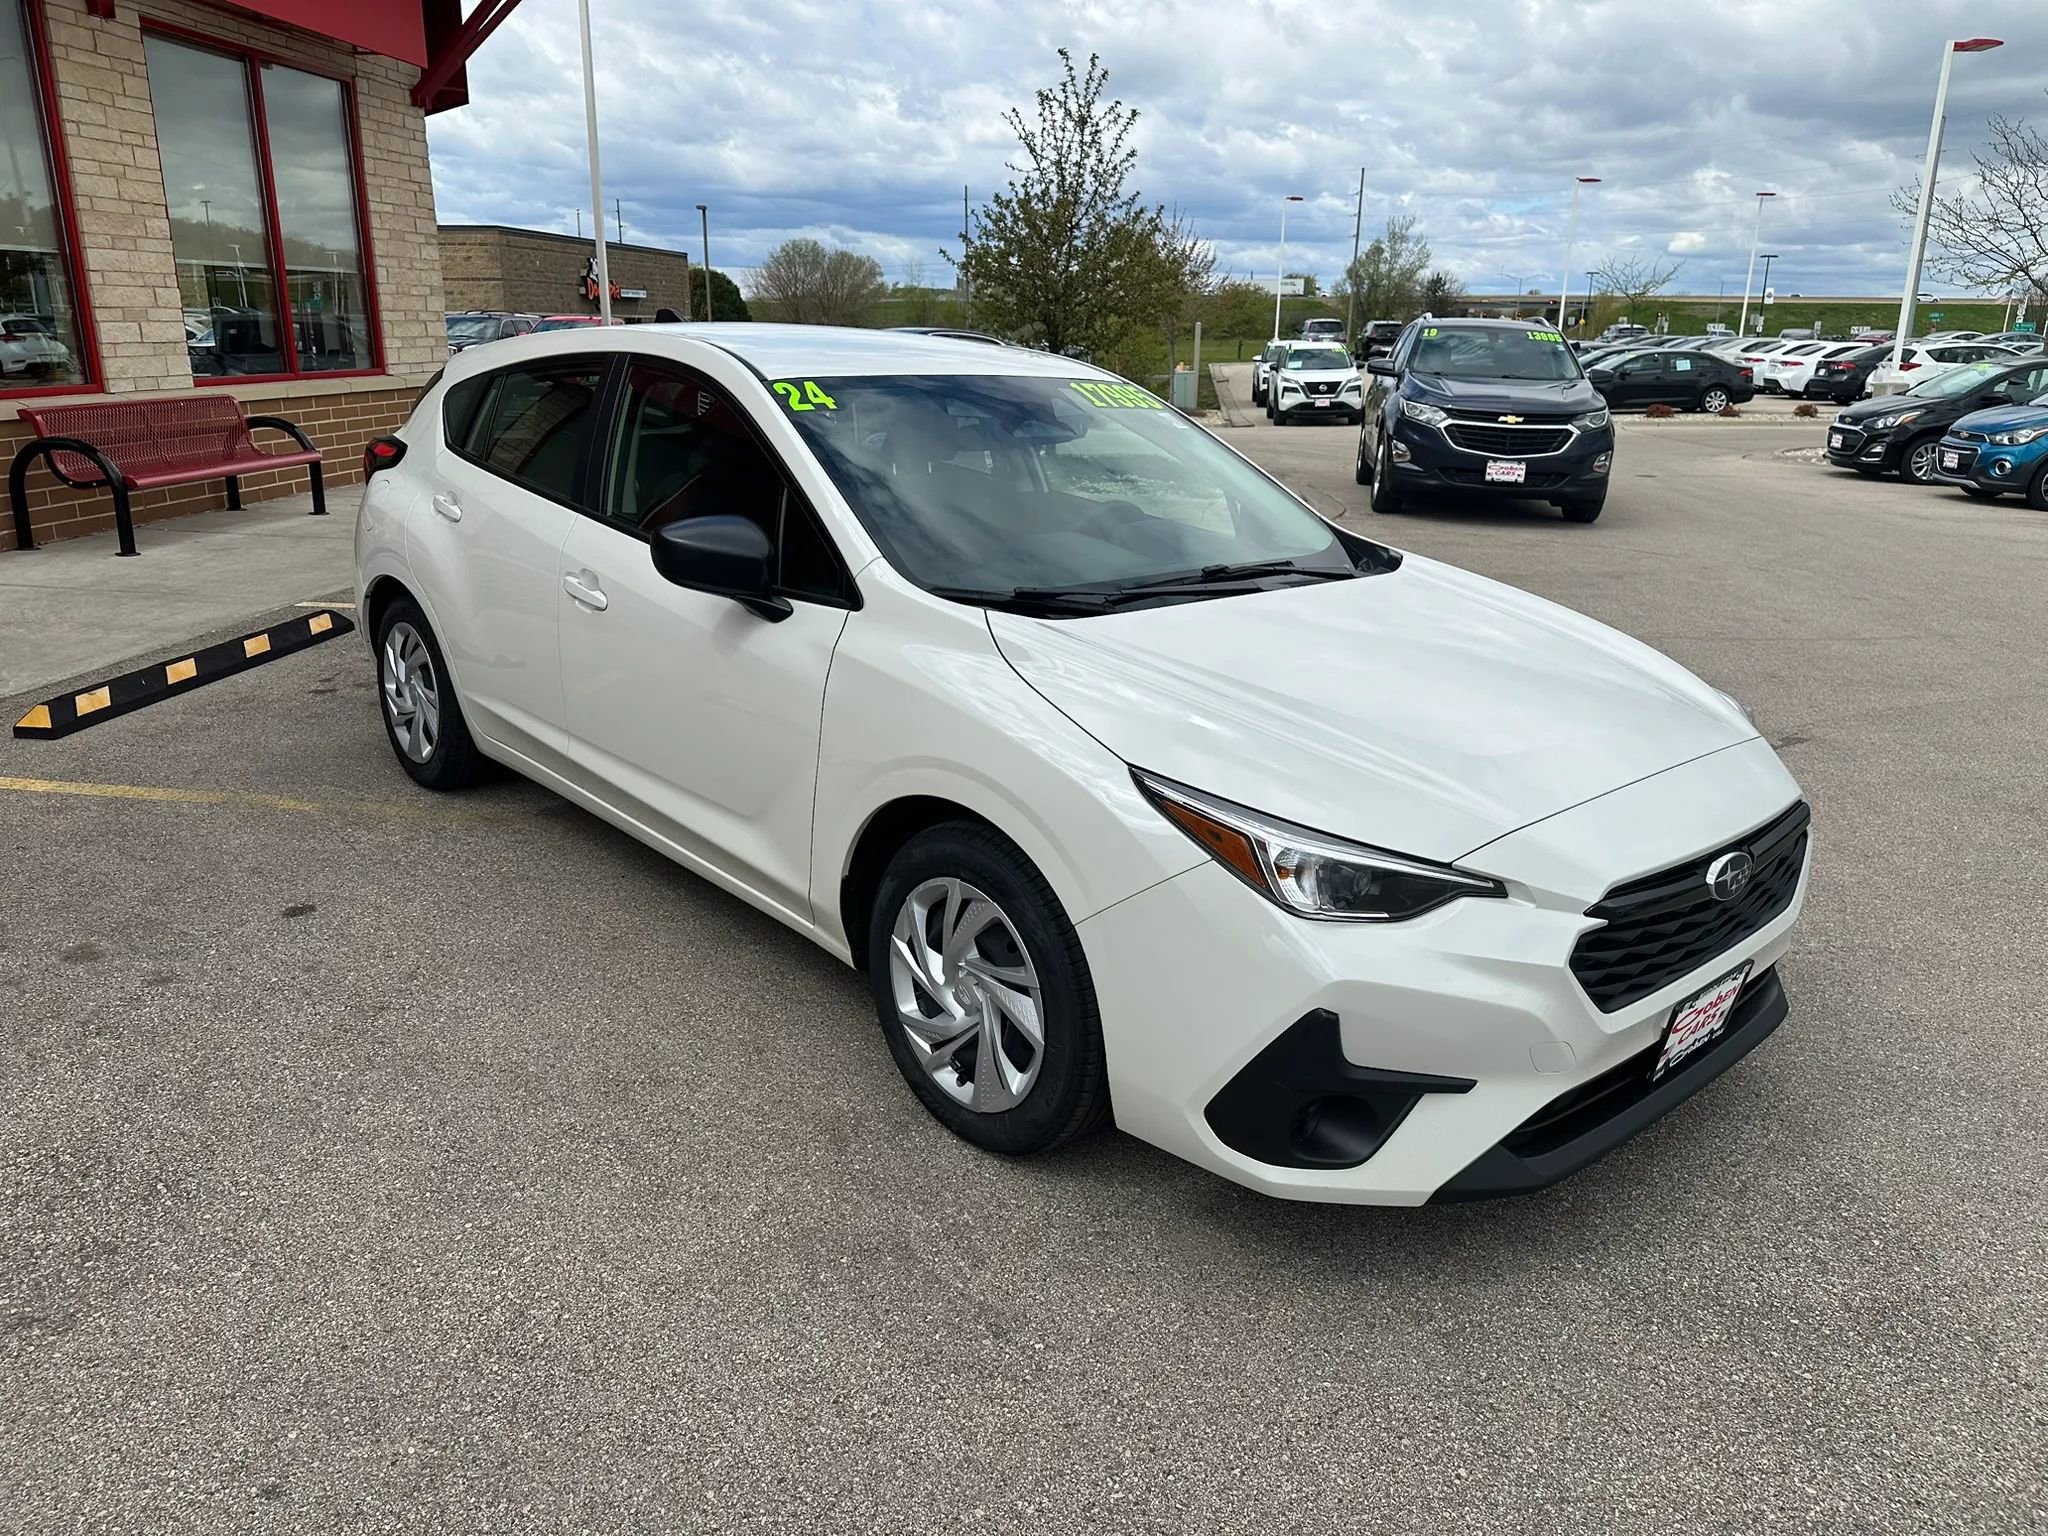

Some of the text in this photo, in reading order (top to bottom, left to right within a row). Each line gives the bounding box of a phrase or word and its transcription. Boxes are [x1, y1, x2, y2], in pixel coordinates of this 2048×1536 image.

[1422, 328, 1438, 337] 19
[773, 381, 837, 411] 24
[1070, 382, 1163, 409] 17995
[1678, 1006, 1721, 1044] CARS
